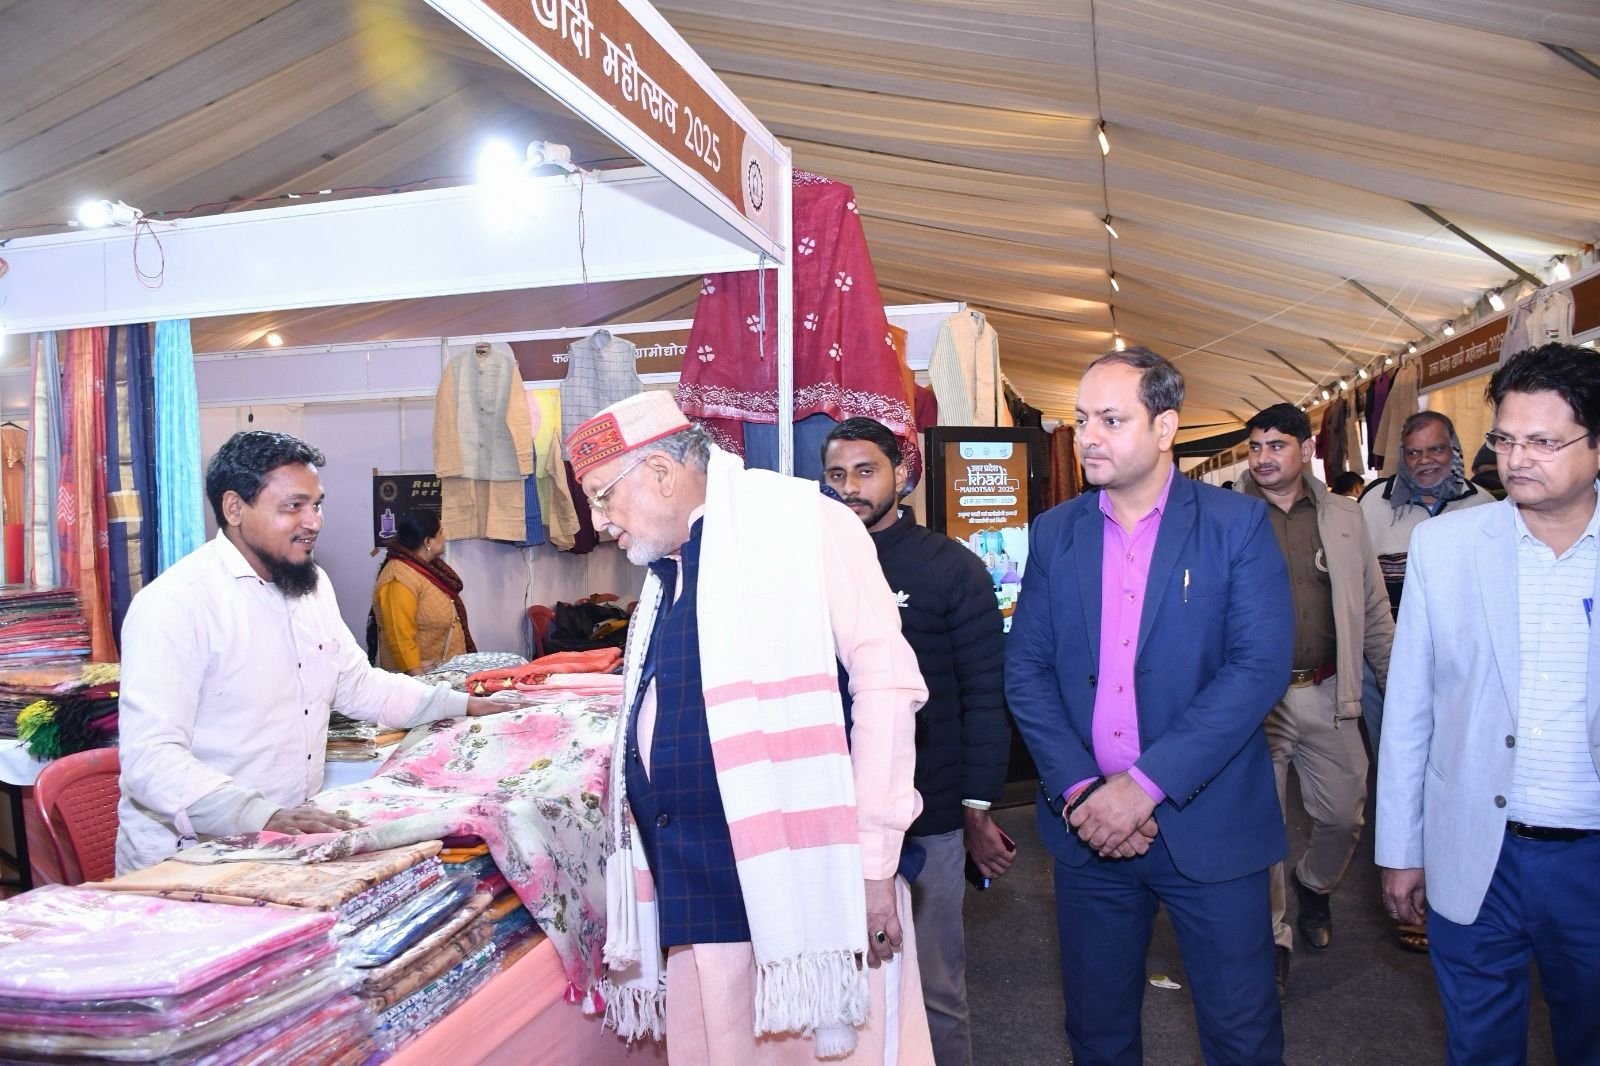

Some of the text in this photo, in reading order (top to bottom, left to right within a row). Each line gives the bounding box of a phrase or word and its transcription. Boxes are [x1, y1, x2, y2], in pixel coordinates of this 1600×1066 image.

[600, 33, 678, 134] महोत्सव
[684, 107, 721, 173] 2025
[412, 480, 441, 488] Rud
